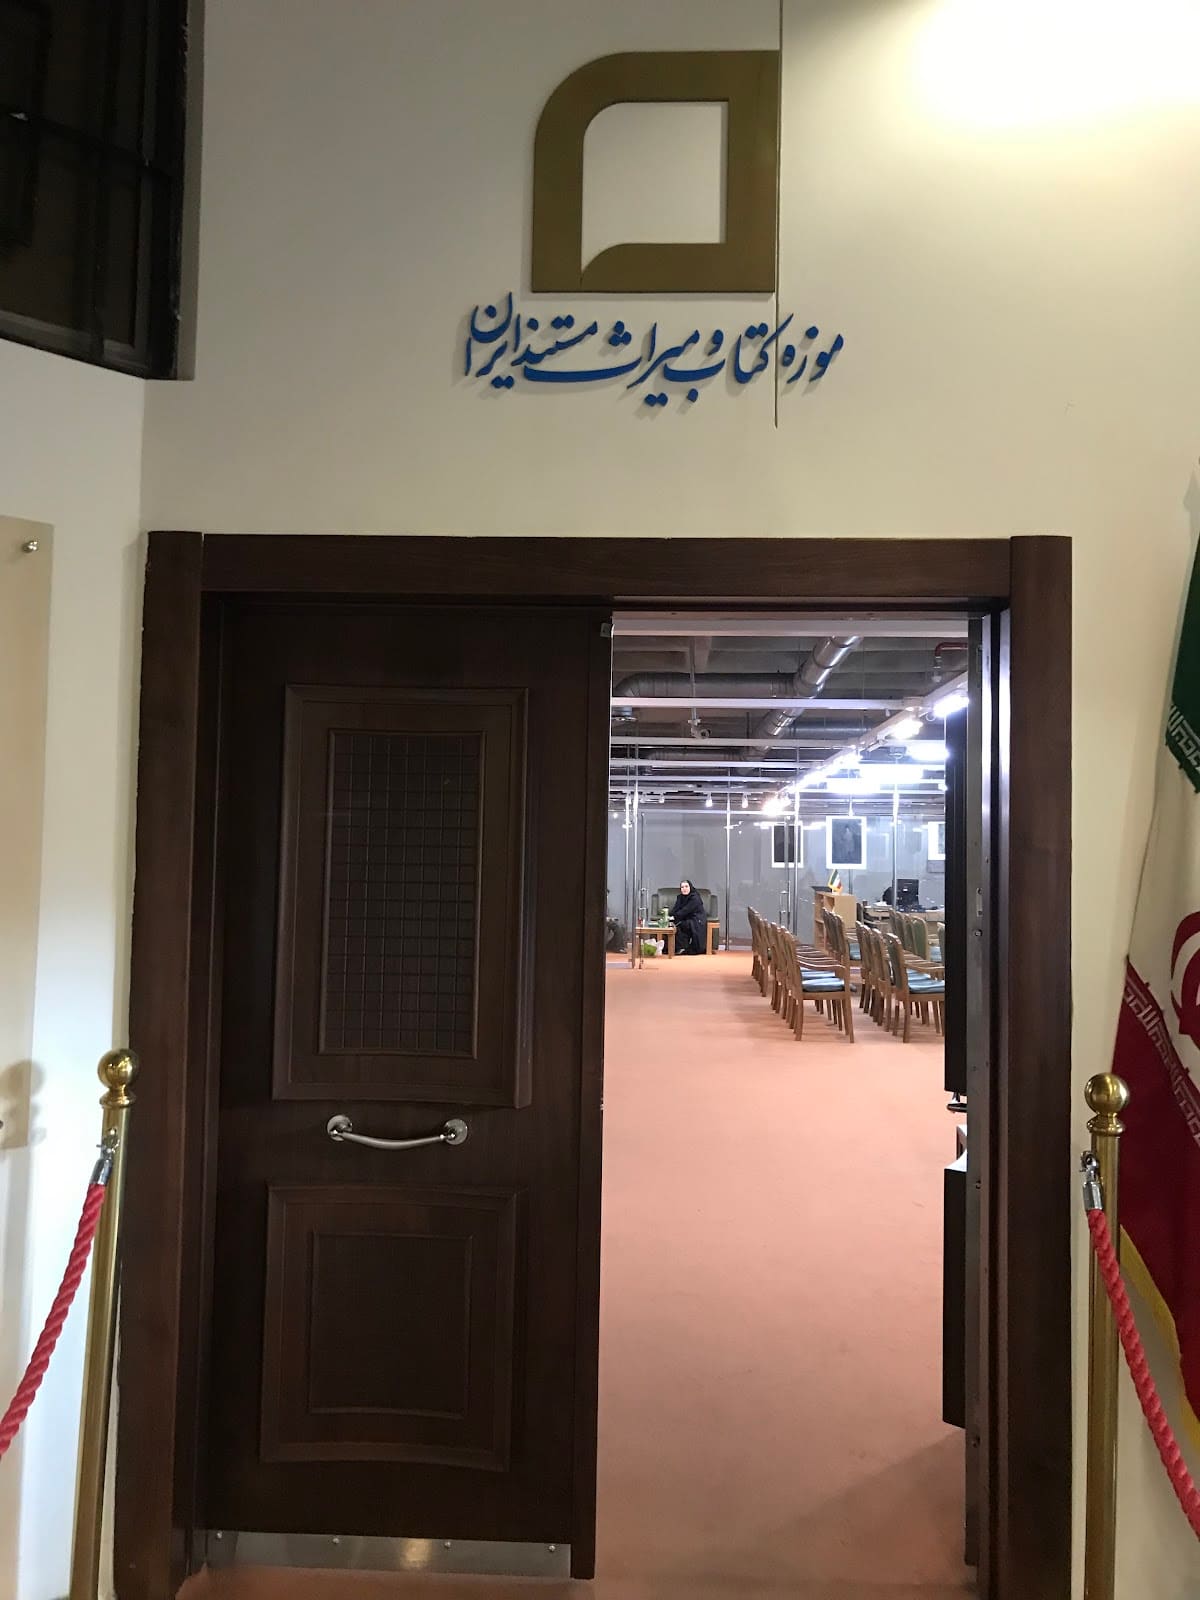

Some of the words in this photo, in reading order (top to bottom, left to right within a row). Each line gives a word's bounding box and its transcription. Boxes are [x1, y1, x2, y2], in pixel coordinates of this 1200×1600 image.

[465, 291, 521, 389] ایران
[511, 315, 599, 366] مستند
[523, 320, 701, 406] میراث
[663, 313, 795, 402] کتاب
[708, 328, 725, 356] و
[781, 326, 844, 383] موزه
